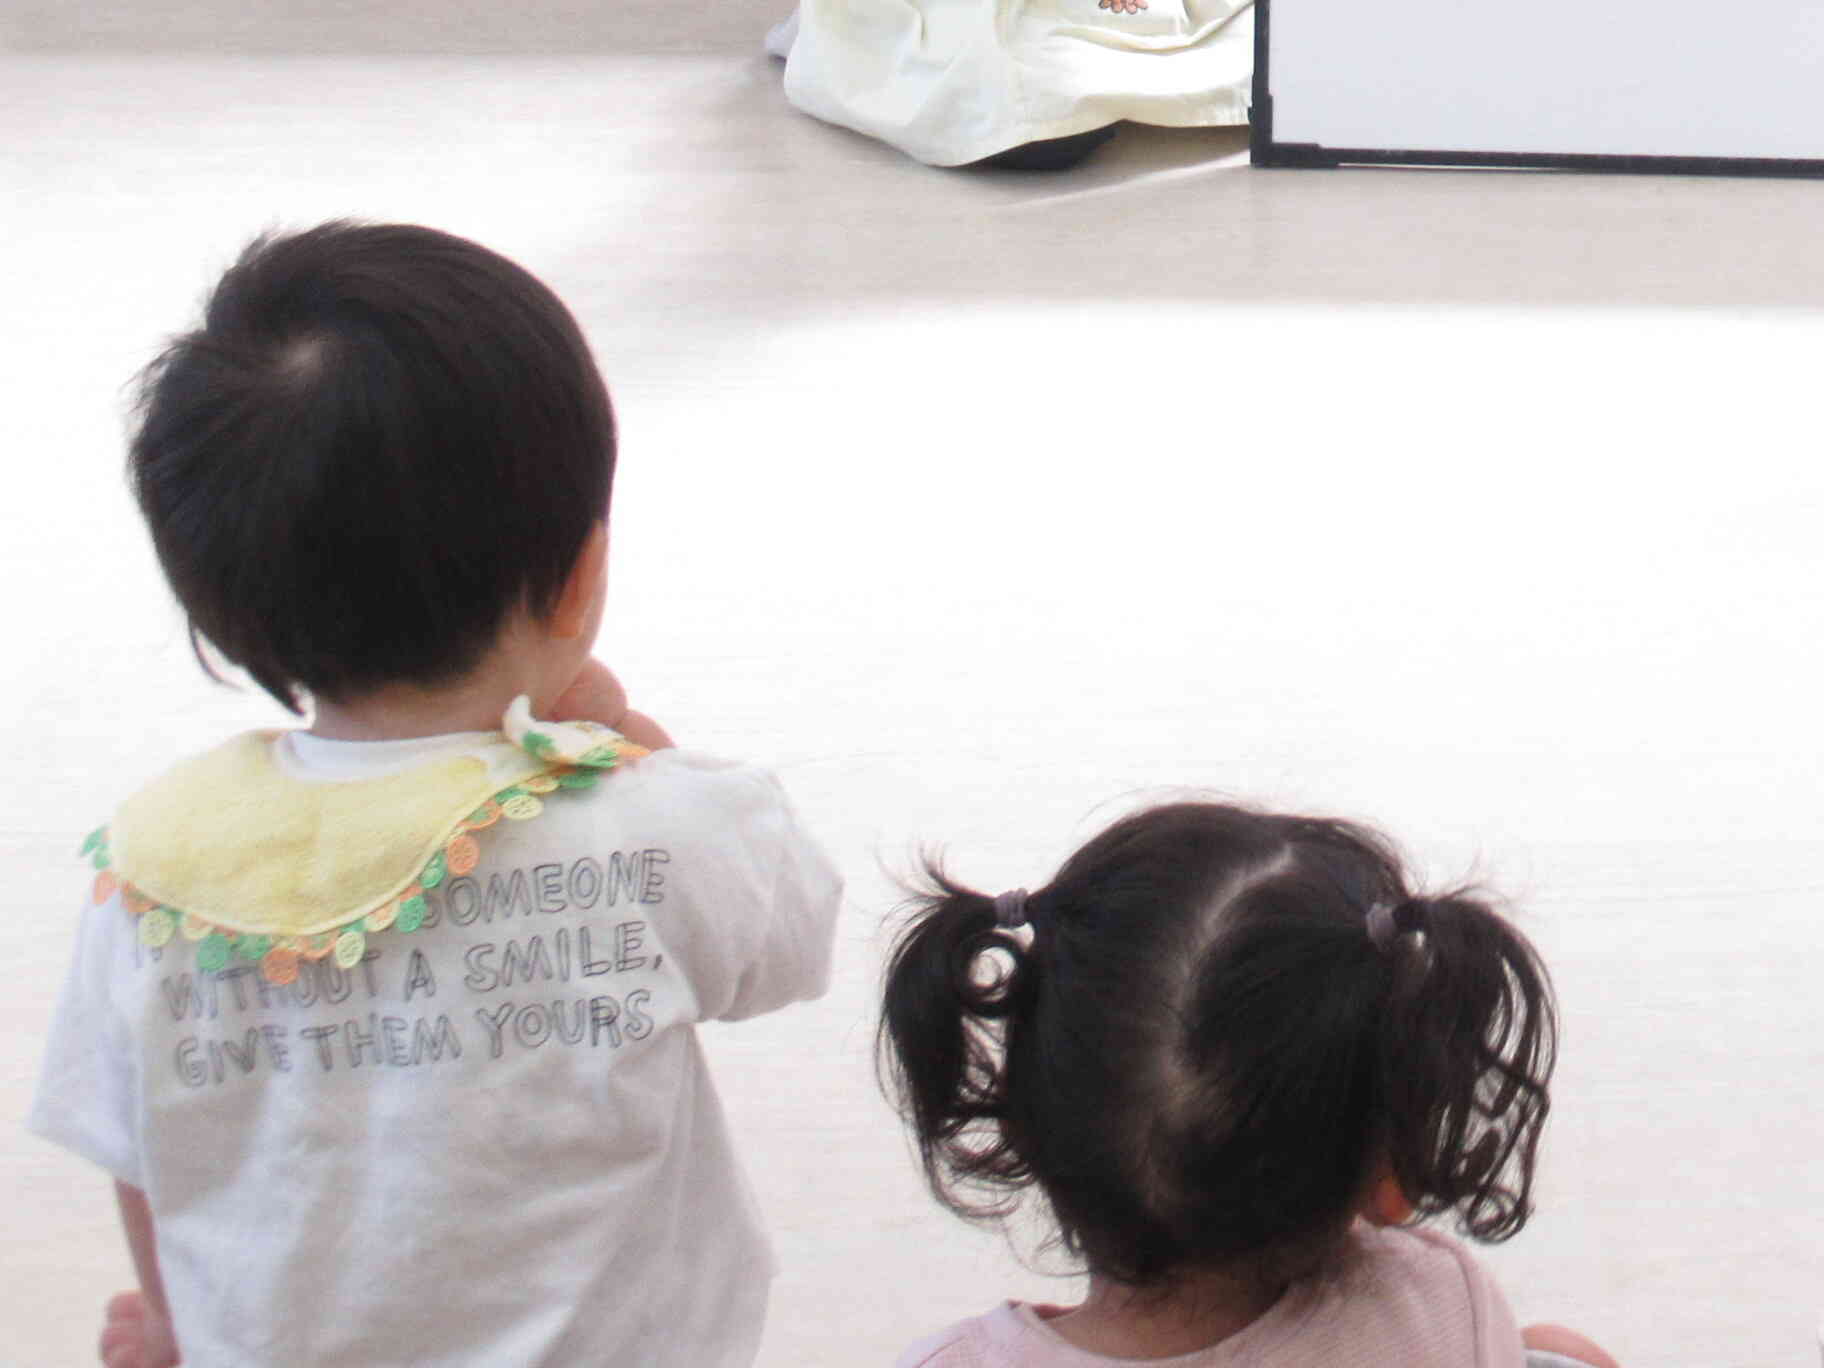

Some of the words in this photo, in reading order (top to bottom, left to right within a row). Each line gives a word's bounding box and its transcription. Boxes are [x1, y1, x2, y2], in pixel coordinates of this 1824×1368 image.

[403, 947, 436, 1003] A
[463, 920, 663, 993] SMILE,
[174, 1024, 293, 1087] GIVE
[300, 1013, 463, 1073] THEM
[475, 988, 655, 1060] YOURS
